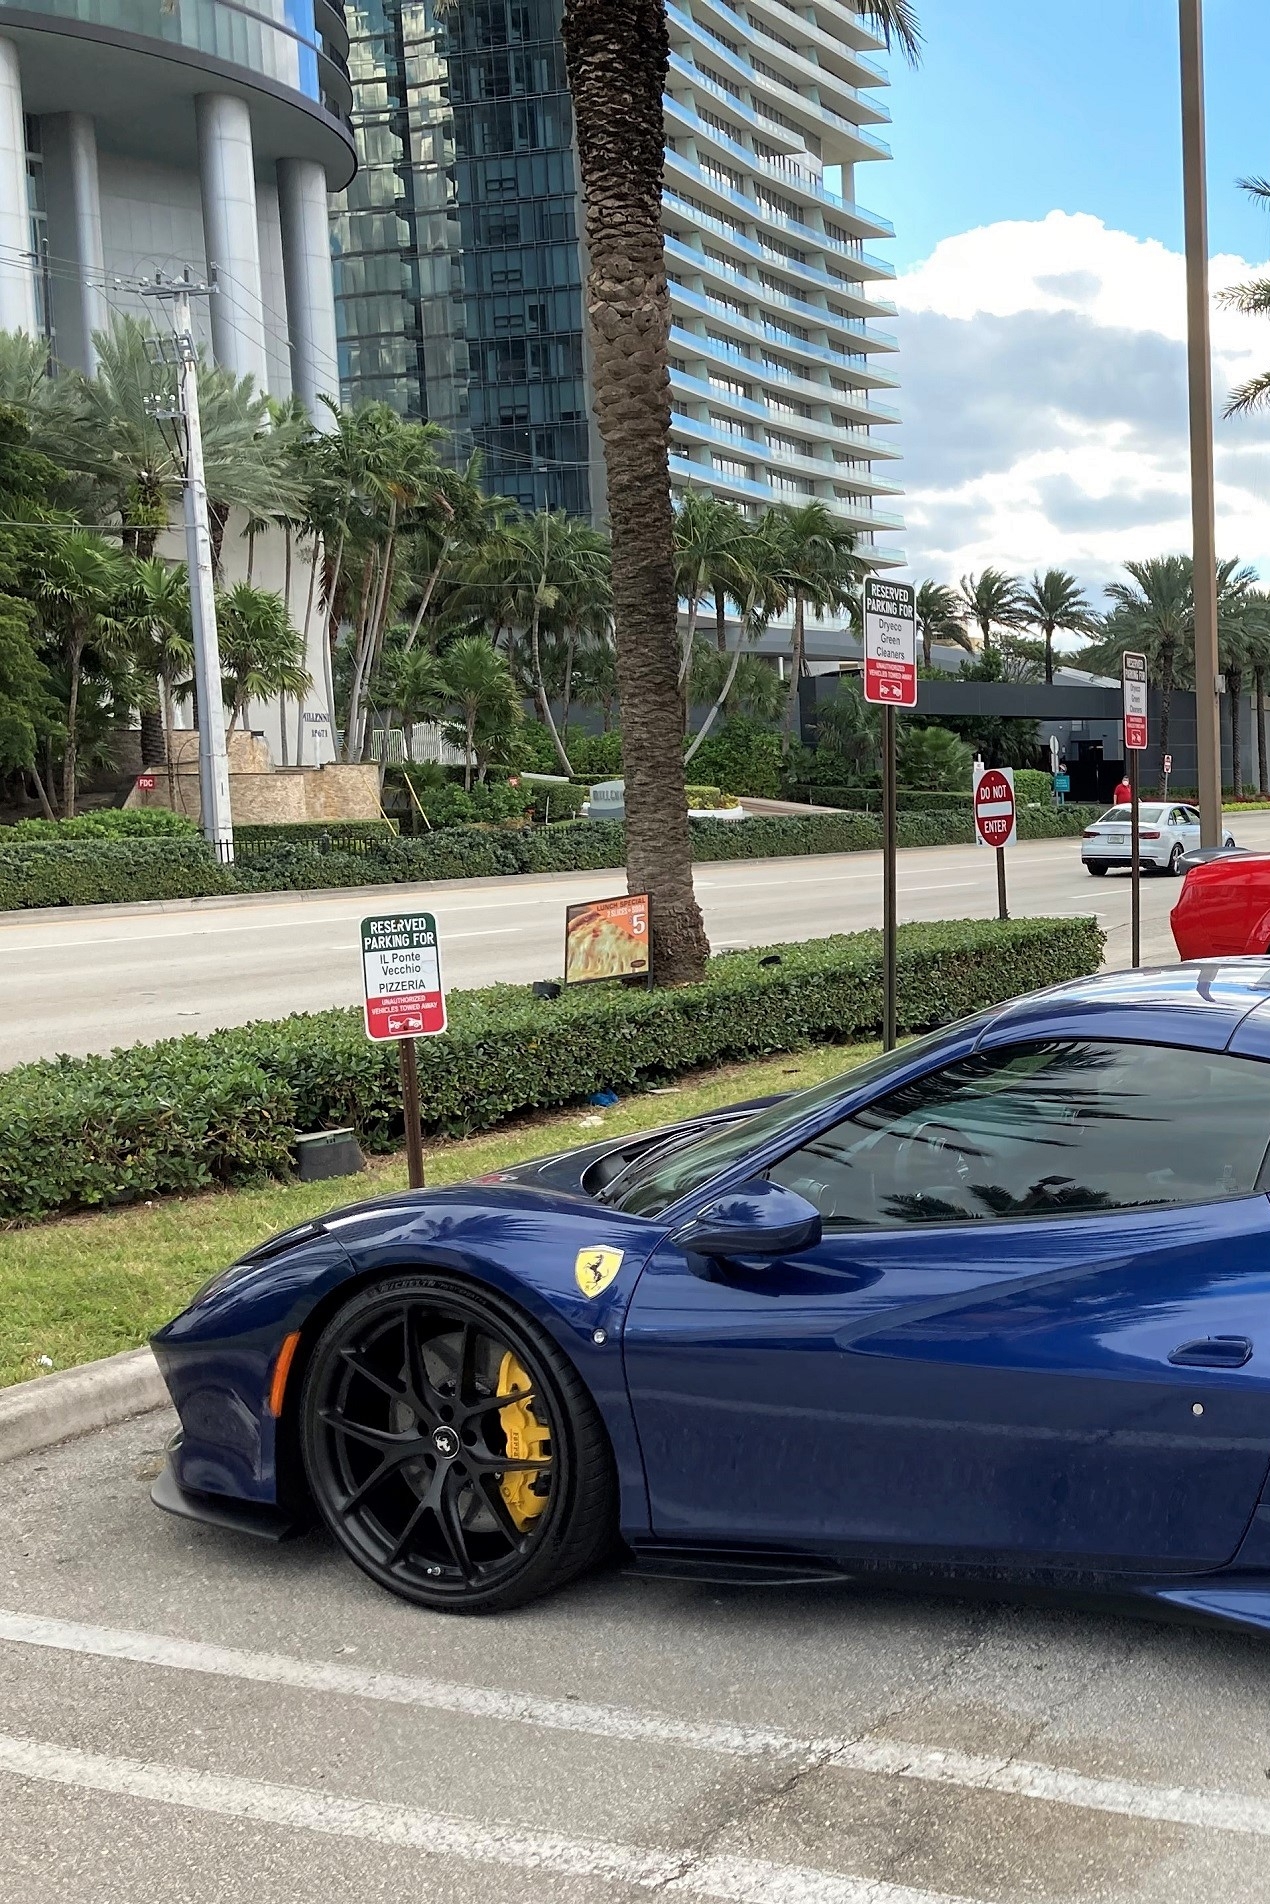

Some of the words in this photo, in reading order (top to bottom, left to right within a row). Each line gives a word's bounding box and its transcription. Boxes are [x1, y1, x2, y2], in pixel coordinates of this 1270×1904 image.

[871, 583, 909, 602] RESERVED
[867, 598, 898, 615] PARKING
[899, 602, 913, 618] FOR
[879, 618, 902, 632] Dryeco
[881, 633, 900, 646] Green
[876, 646, 905, 660] Cleaners
[140, 779, 153, 787] FDC
[980, 786, 991, 800] DO
[993, 785, 1007, 798] NOT
[984, 819, 1007, 834] ENTER
[597, 902, 618, 911] LUNCH
[620, 898, 646, 908] SPECIAL
[370, 918, 426, 934] RESERVED
[364, 934, 410, 950] PARKING
[413, 932, 435, 946] FOR
[392, 952, 421, 963] Ponte
[382, 964, 421, 976] Vecchio
[379, 979, 426, 993] PIZZERIA
[381, 995, 426, 1005] UNAUTHORIZED
[371, 1005, 399, 1015] VEHICLES
[399, 1003, 420, 1012] TOWED
[421, 1001, 438, 1010] AWAY
[380, 1279, 436, 1293] MICHELIN
